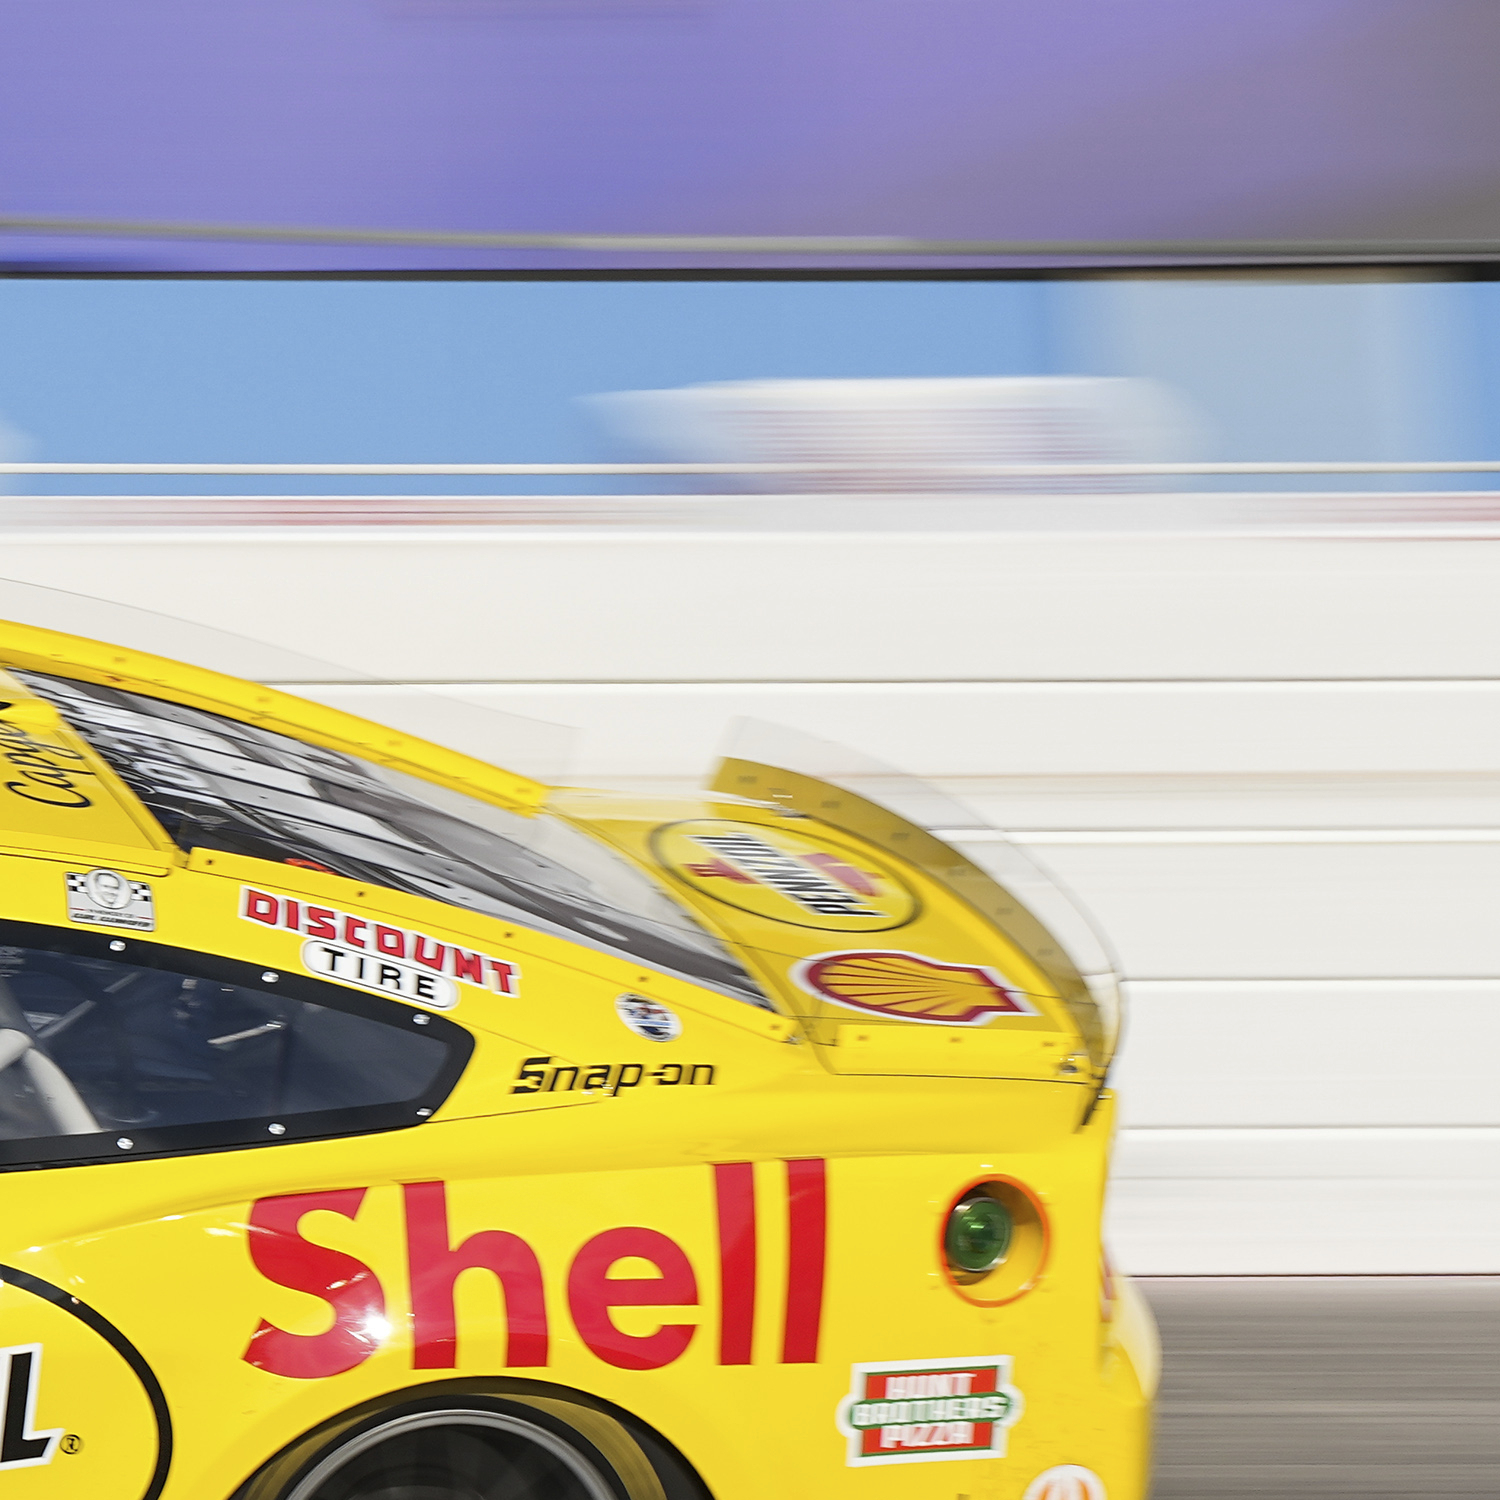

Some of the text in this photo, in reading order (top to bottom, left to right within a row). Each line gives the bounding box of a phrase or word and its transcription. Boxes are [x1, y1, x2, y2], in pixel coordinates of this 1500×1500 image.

[239, 885, 521, 998] DISCOUNT
[323, 947, 435, 999] TIRE
[508, 1056, 716, 1097] Snap-on
[241, 1157, 828, 1379] Shell
[885, 1373, 977, 1399] HUNT
[852, 1396, 1009, 1426] BROTHERS
[879, 1421, 975, 1449] PIZZA
